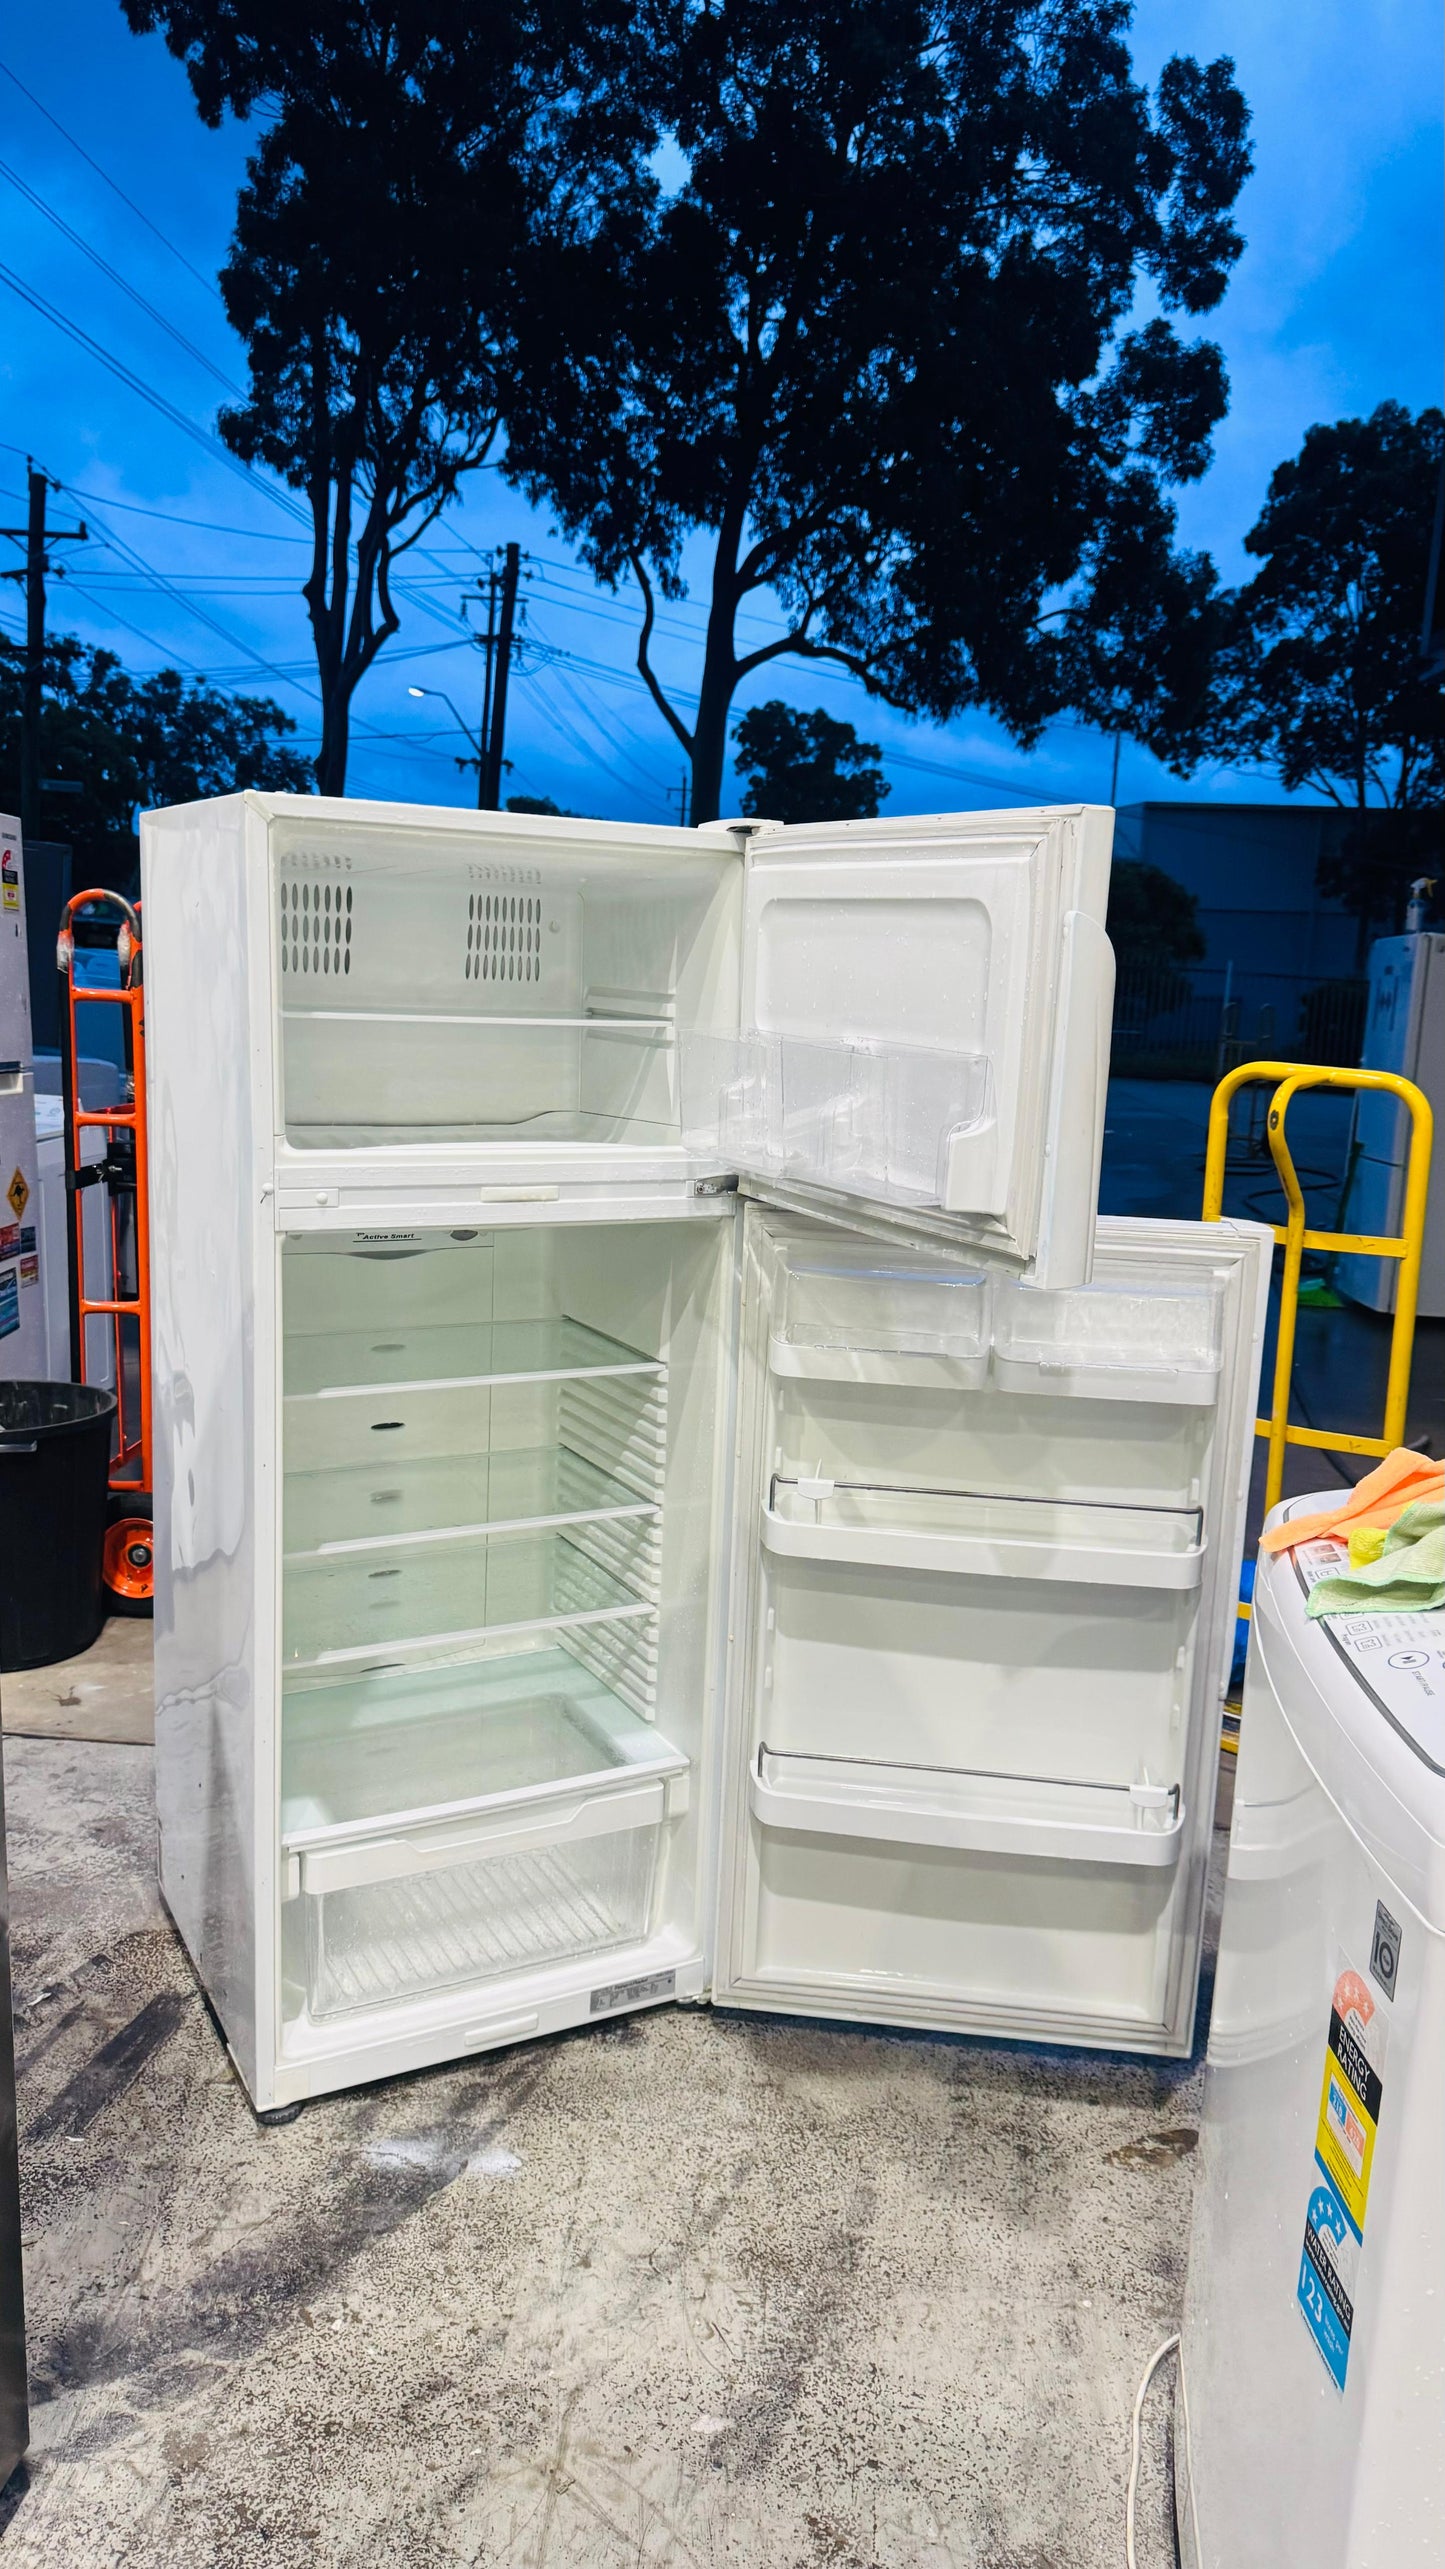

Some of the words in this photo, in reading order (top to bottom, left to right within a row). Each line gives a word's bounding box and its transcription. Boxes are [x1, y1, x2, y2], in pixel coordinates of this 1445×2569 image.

[1373, 1930, 1394, 1979] 10
[1336, 2042, 1368, 2102] RATING
[1338, 2024, 1371, 2080] ENERGY
[1307, 2227, 1327, 2275] WATER
[1301, 2262, 1323, 2324] 123
[1326, 2271, 1351, 2320] RATING
